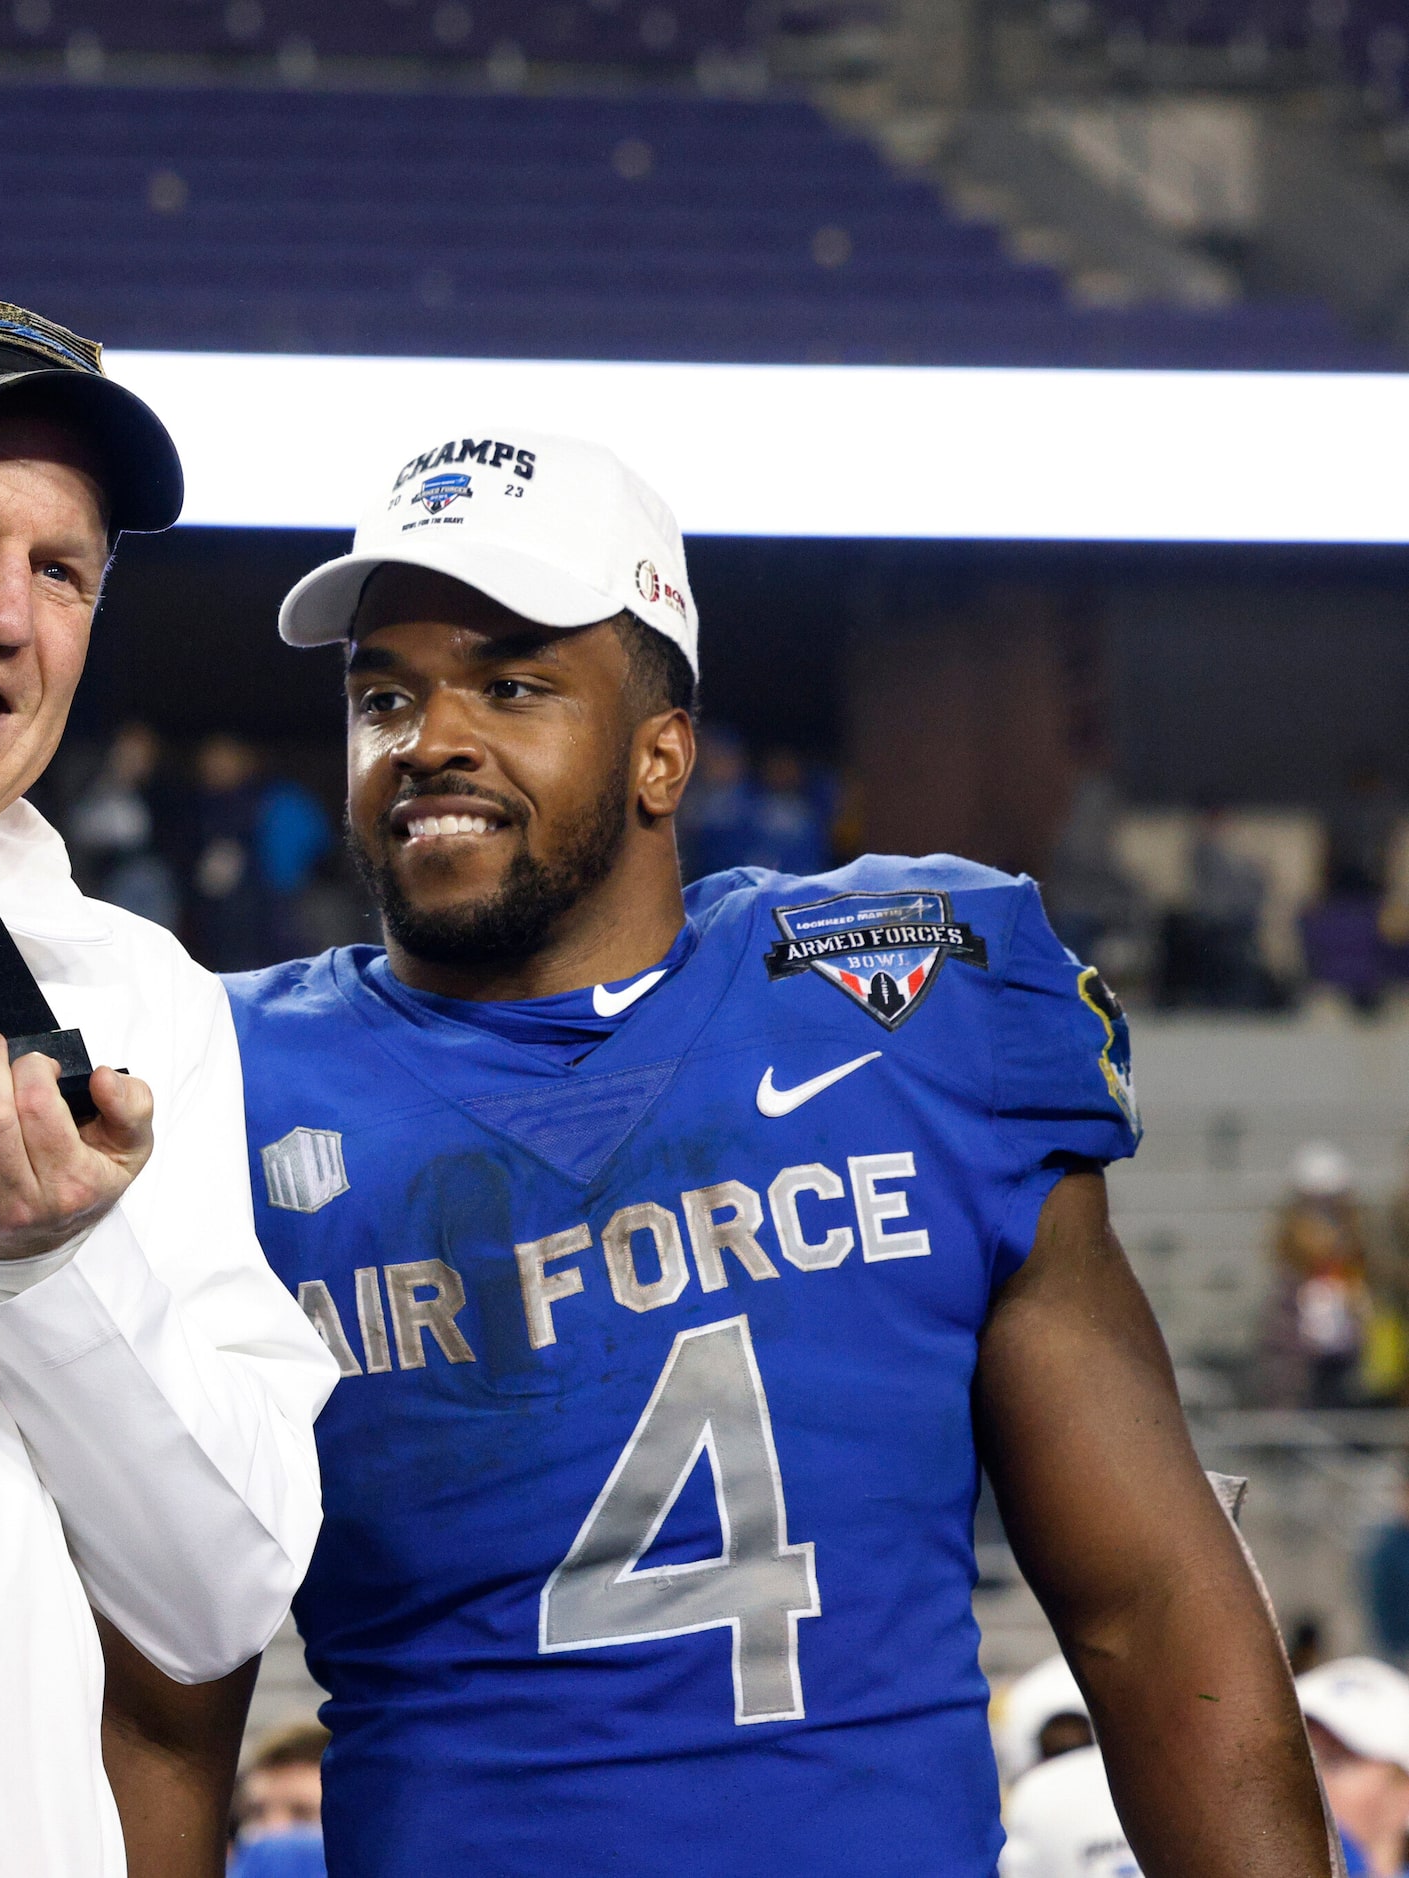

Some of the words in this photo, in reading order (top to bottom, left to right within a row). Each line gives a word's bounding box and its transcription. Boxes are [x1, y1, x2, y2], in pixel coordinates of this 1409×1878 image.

[393, 438, 536, 491] CHAMPS
[504, 484, 524, 498] 23
[796, 914, 854, 930] LOCKHEED
[787, 931, 865, 961] ARMED
[870, 927, 964, 946] FORCES
[847, 953, 911, 969] BOWL
[297, 1258, 476, 1377] AIR
[514, 1151, 931, 1350] FORCE
[538, 1314, 821, 1725] 4
